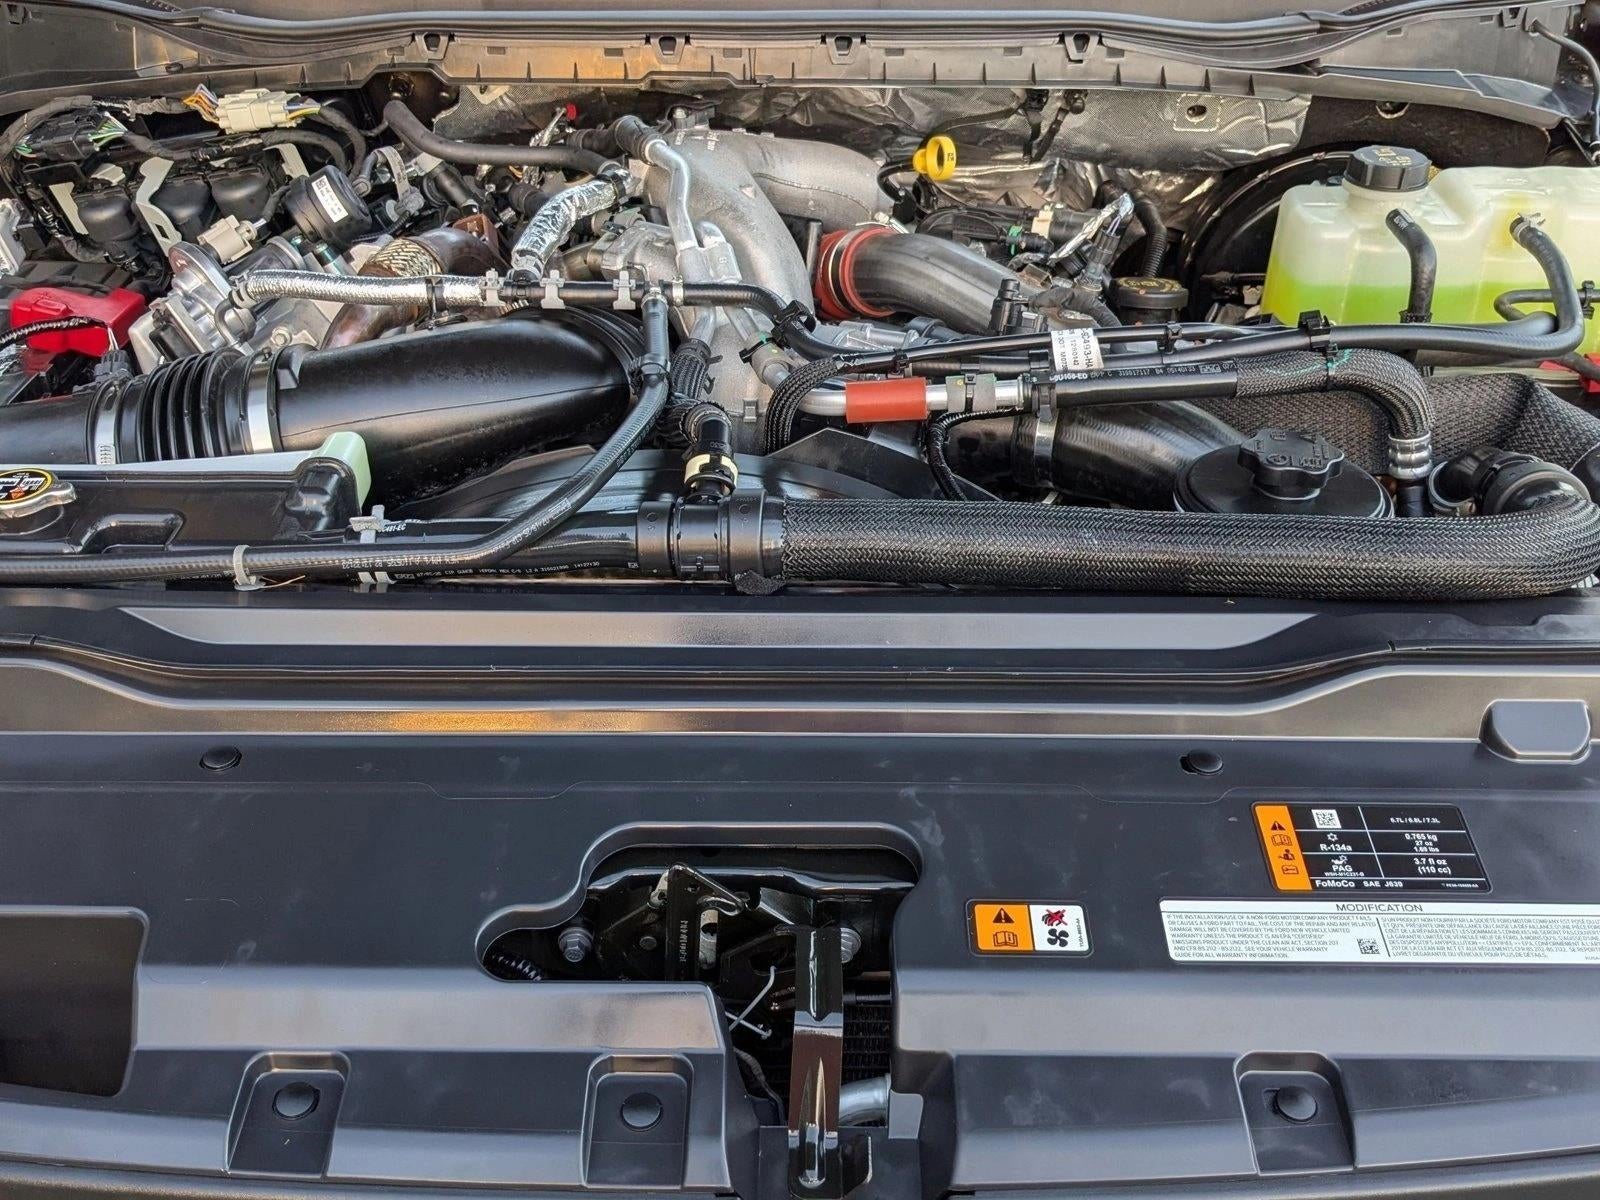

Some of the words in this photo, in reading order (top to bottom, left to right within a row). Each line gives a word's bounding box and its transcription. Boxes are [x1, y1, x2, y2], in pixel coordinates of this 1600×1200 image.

[1427, 834, 1438, 842] kg
[1418, 866, 1436, 875] (110
[1438, 866, 1452, 875] cc)
[1336, 904, 1423, 912] MODIFICATION
